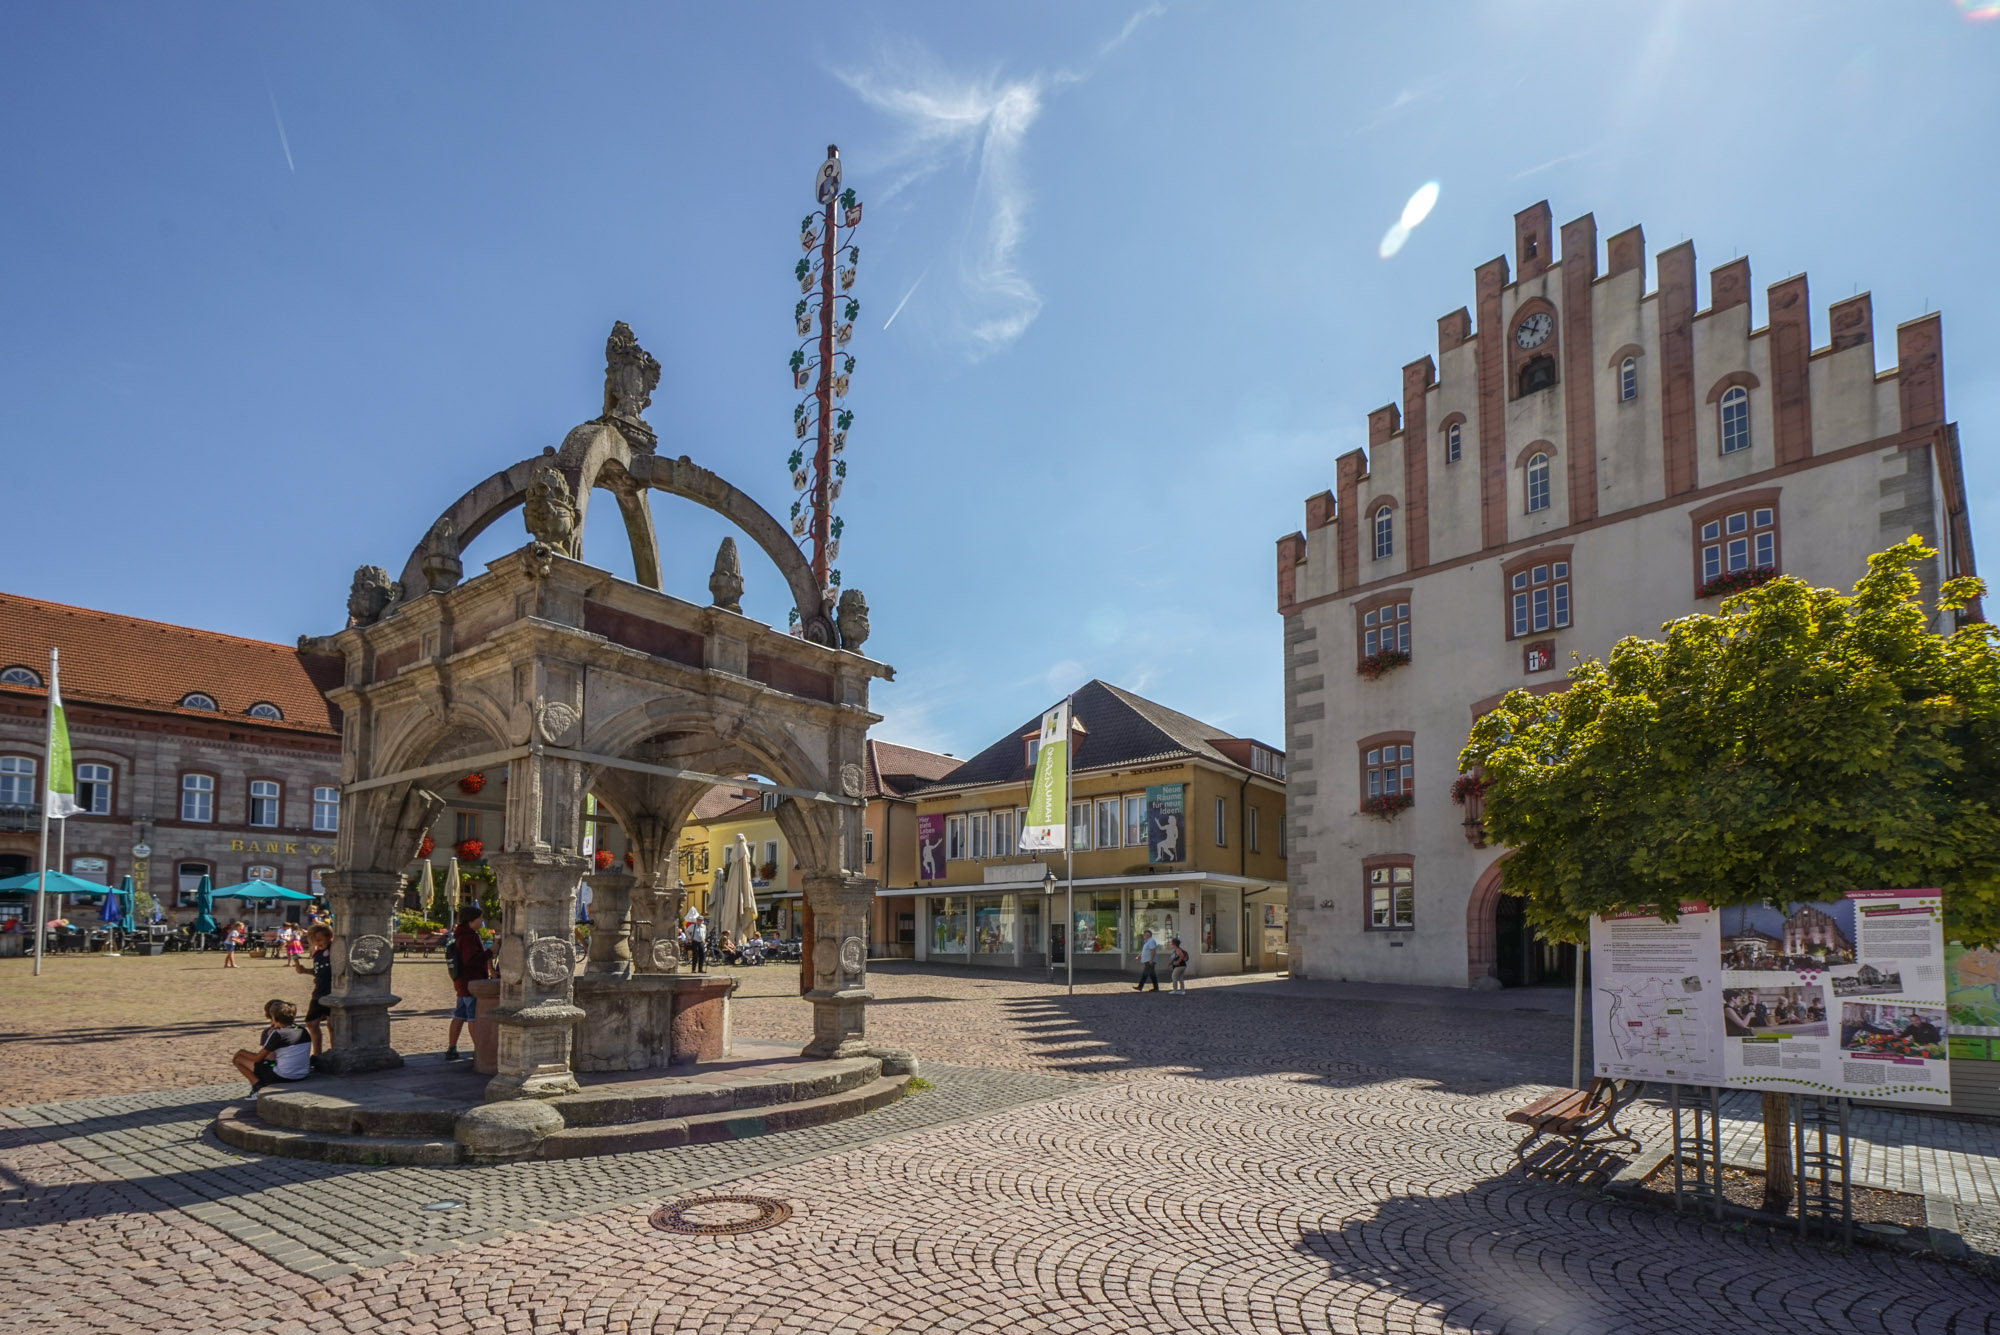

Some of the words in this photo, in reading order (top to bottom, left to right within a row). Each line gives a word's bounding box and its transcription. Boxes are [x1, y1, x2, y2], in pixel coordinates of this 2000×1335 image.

[1156, 793, 1182, 801] Räume
[1152, 801, 1163, 809] für
[1164, 800, 1182, 808] neue
[230, 839, 299, 856] BANK
